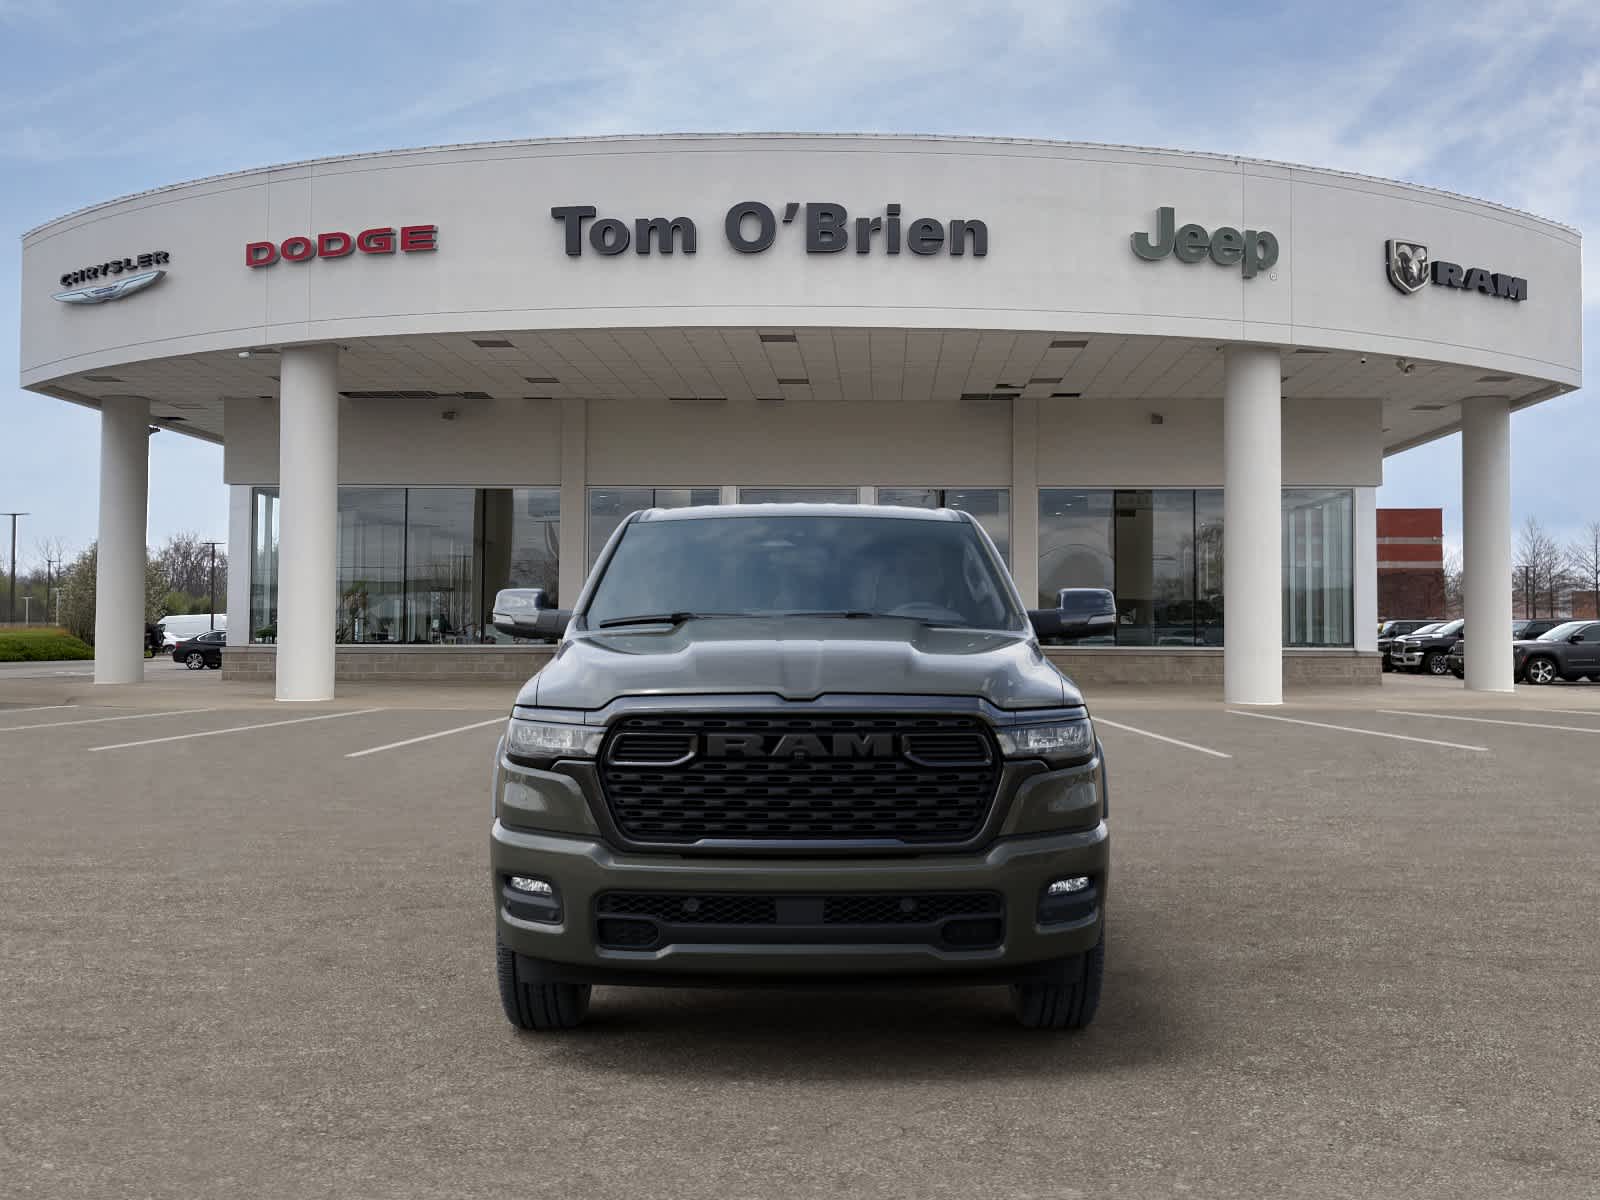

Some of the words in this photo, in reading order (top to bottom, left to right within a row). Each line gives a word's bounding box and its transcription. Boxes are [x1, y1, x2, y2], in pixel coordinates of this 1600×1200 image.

[245, 224, 438, 268] DODGE
[551, 204, 697, 256] Tom
[725, 201, 988, 257] O'Brien
[1130, 206, 1279, 279] Jeep
[60, 250, 170, 286] CHRYSLER
[1431, 260, 1528, 301] RAM
[706, 732, 893, 757] RAM
